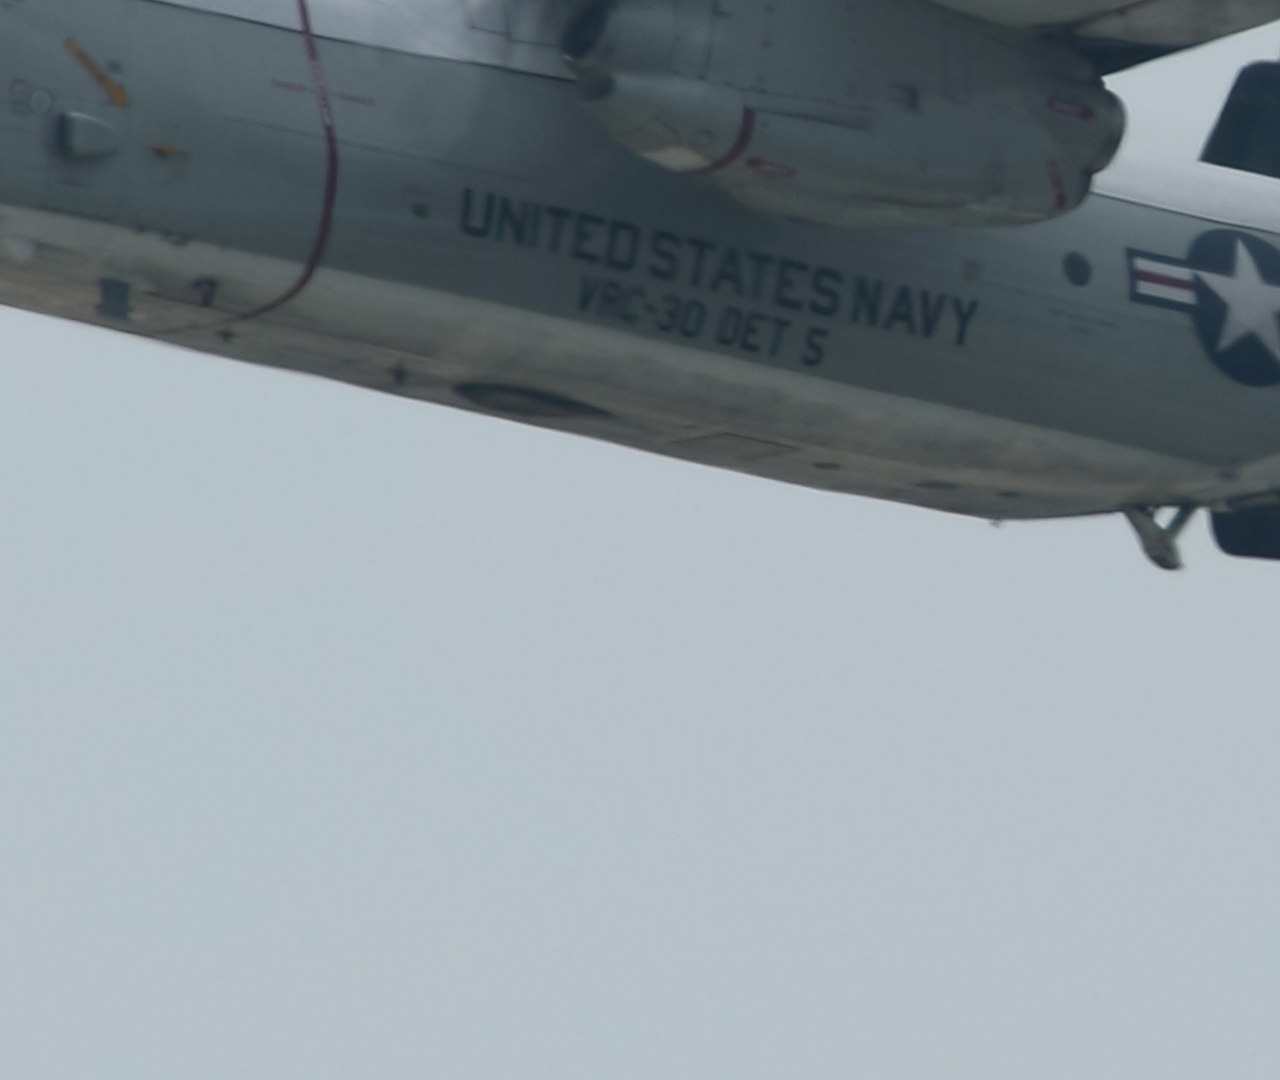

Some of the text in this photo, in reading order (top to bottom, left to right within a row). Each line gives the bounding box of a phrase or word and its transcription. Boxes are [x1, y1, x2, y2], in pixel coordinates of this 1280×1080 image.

[460, 187, 979, 347] UNITED STATES NAVY
[576, 273, 707, 339] VRC-30
[716, 304, 792, 358] DET
